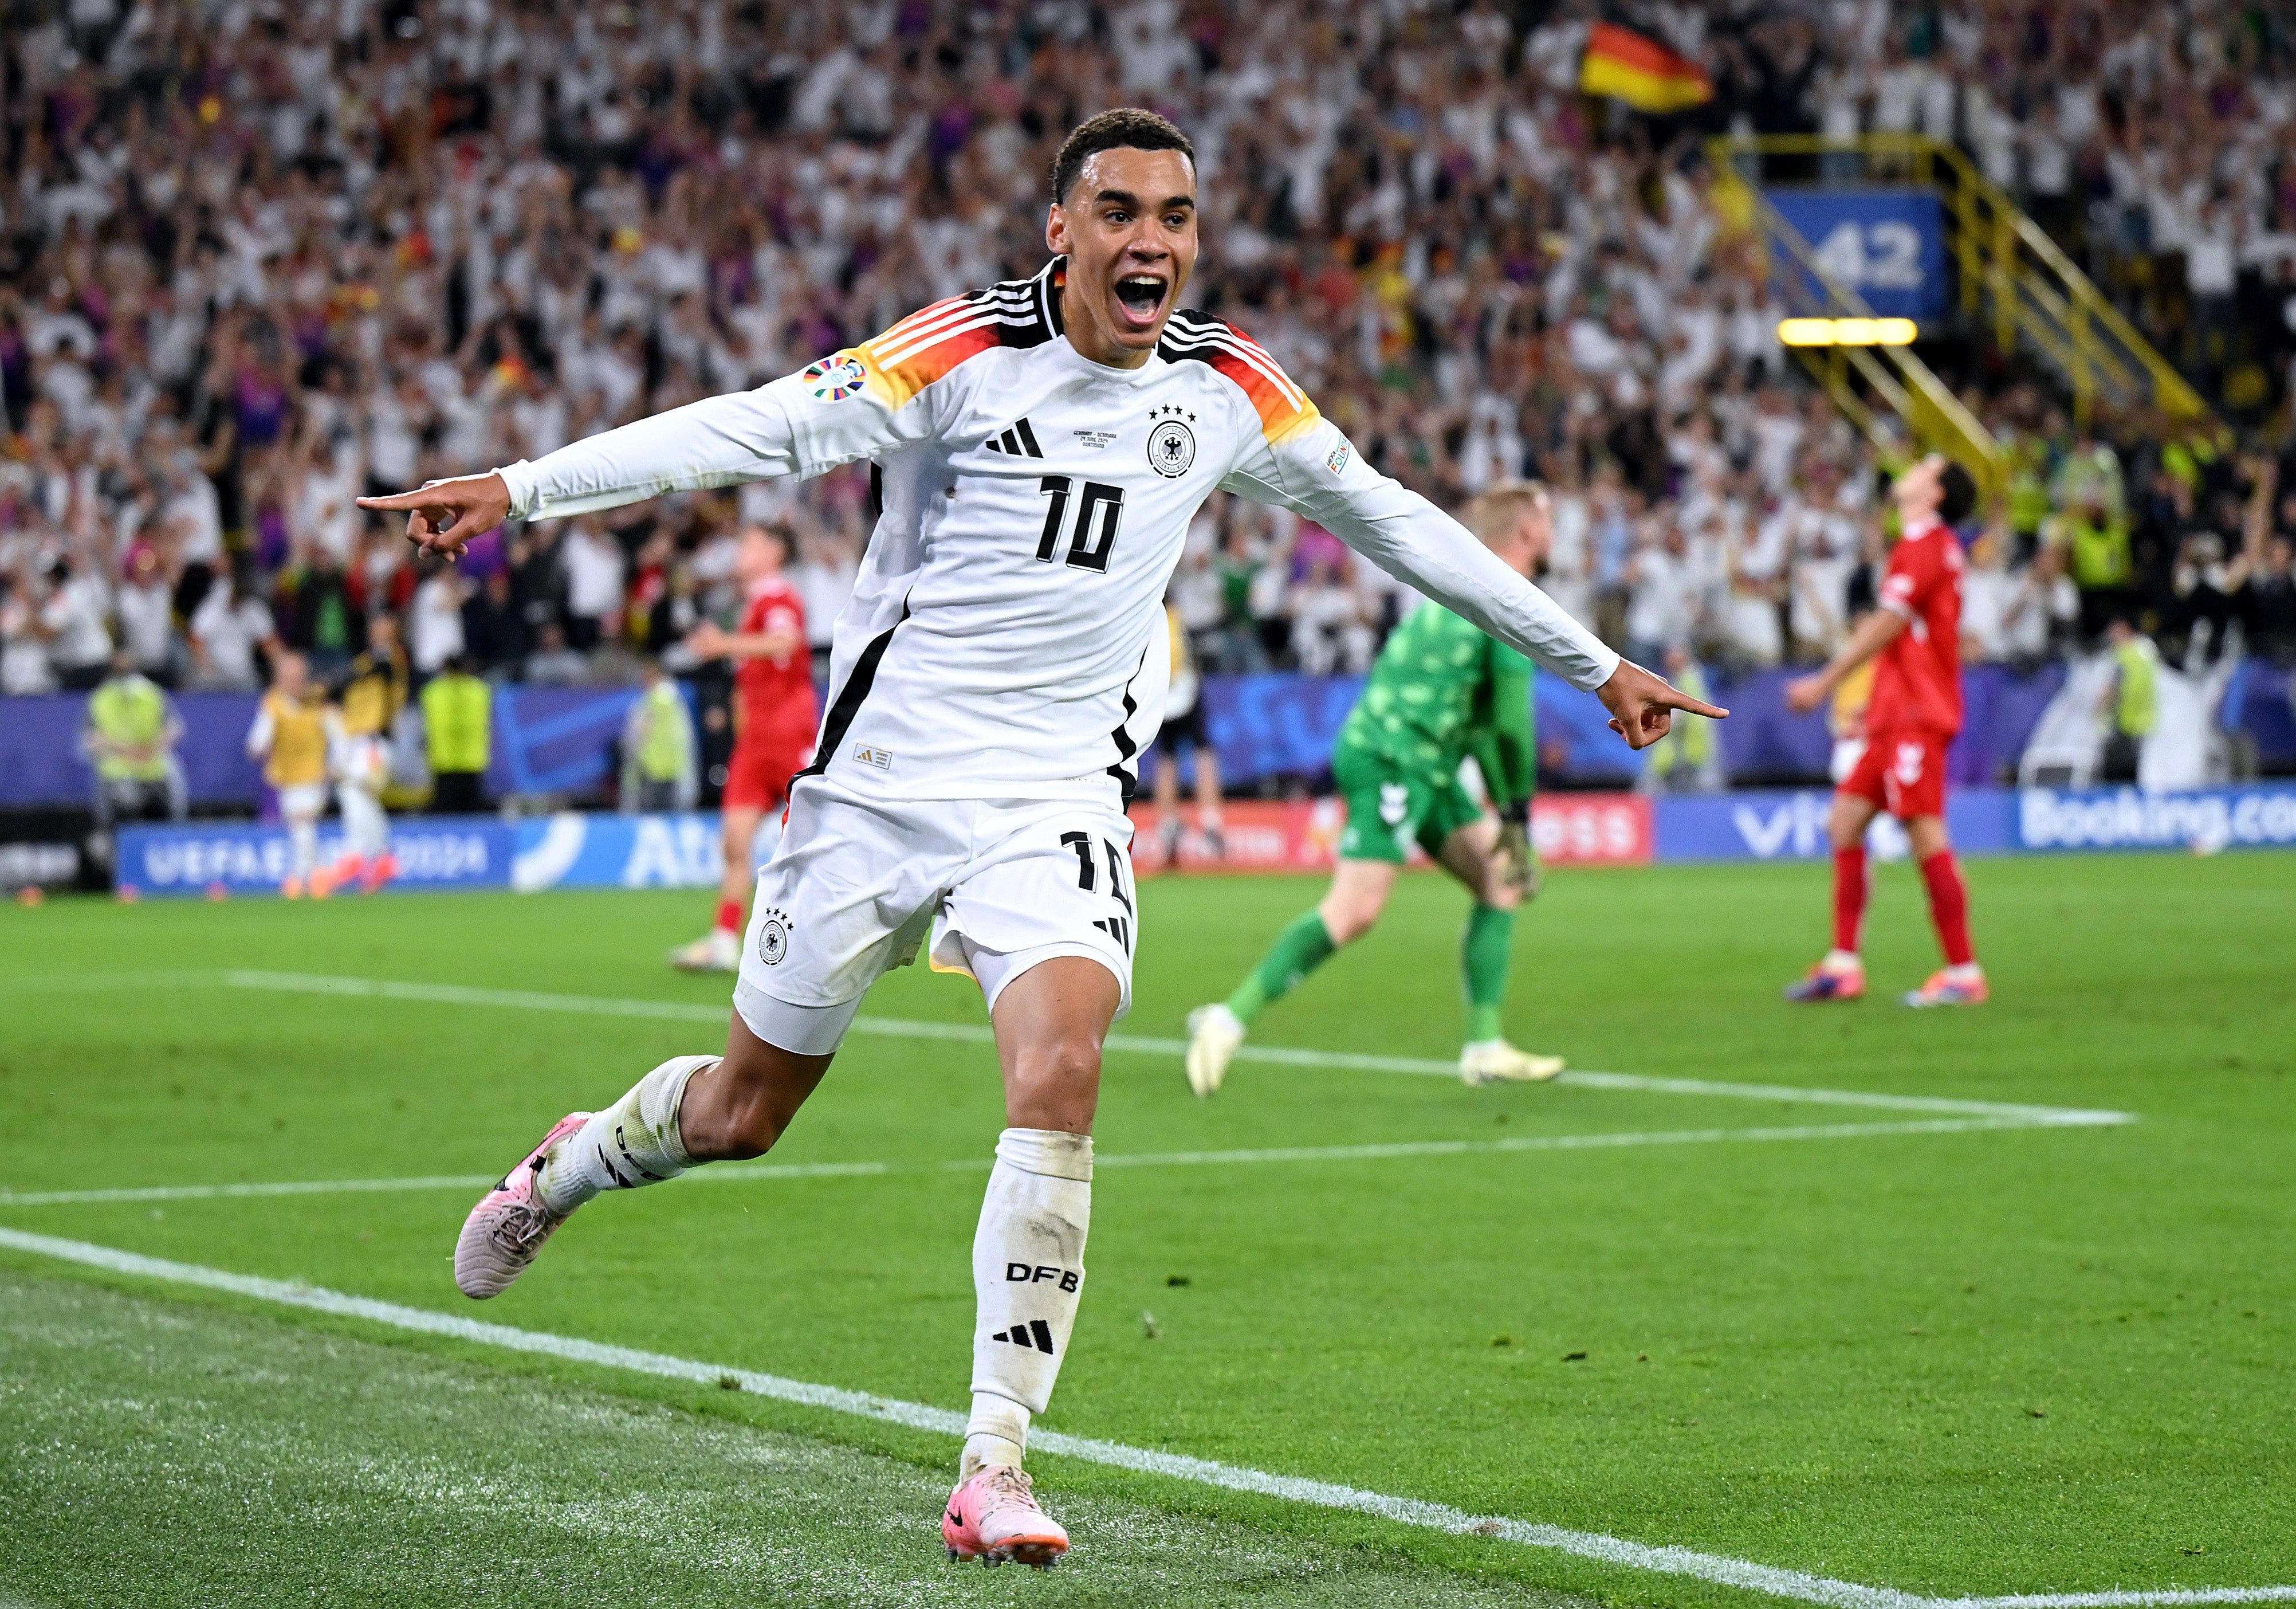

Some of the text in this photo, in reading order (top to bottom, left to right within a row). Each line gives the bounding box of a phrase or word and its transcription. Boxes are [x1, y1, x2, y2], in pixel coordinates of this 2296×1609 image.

[1815, 220, 1924, 291] 42
[1159, 427, 1186, 439] DEUTSCHER
[1326, 451, 1336, 466] UEFA
[1035, 475, 1126, 574] 10
[2021, 788, 2296, 849] Booking.co
[143, 838, 262, 885] UEFA
[1006, 1262, 1079, 1293] DFB
